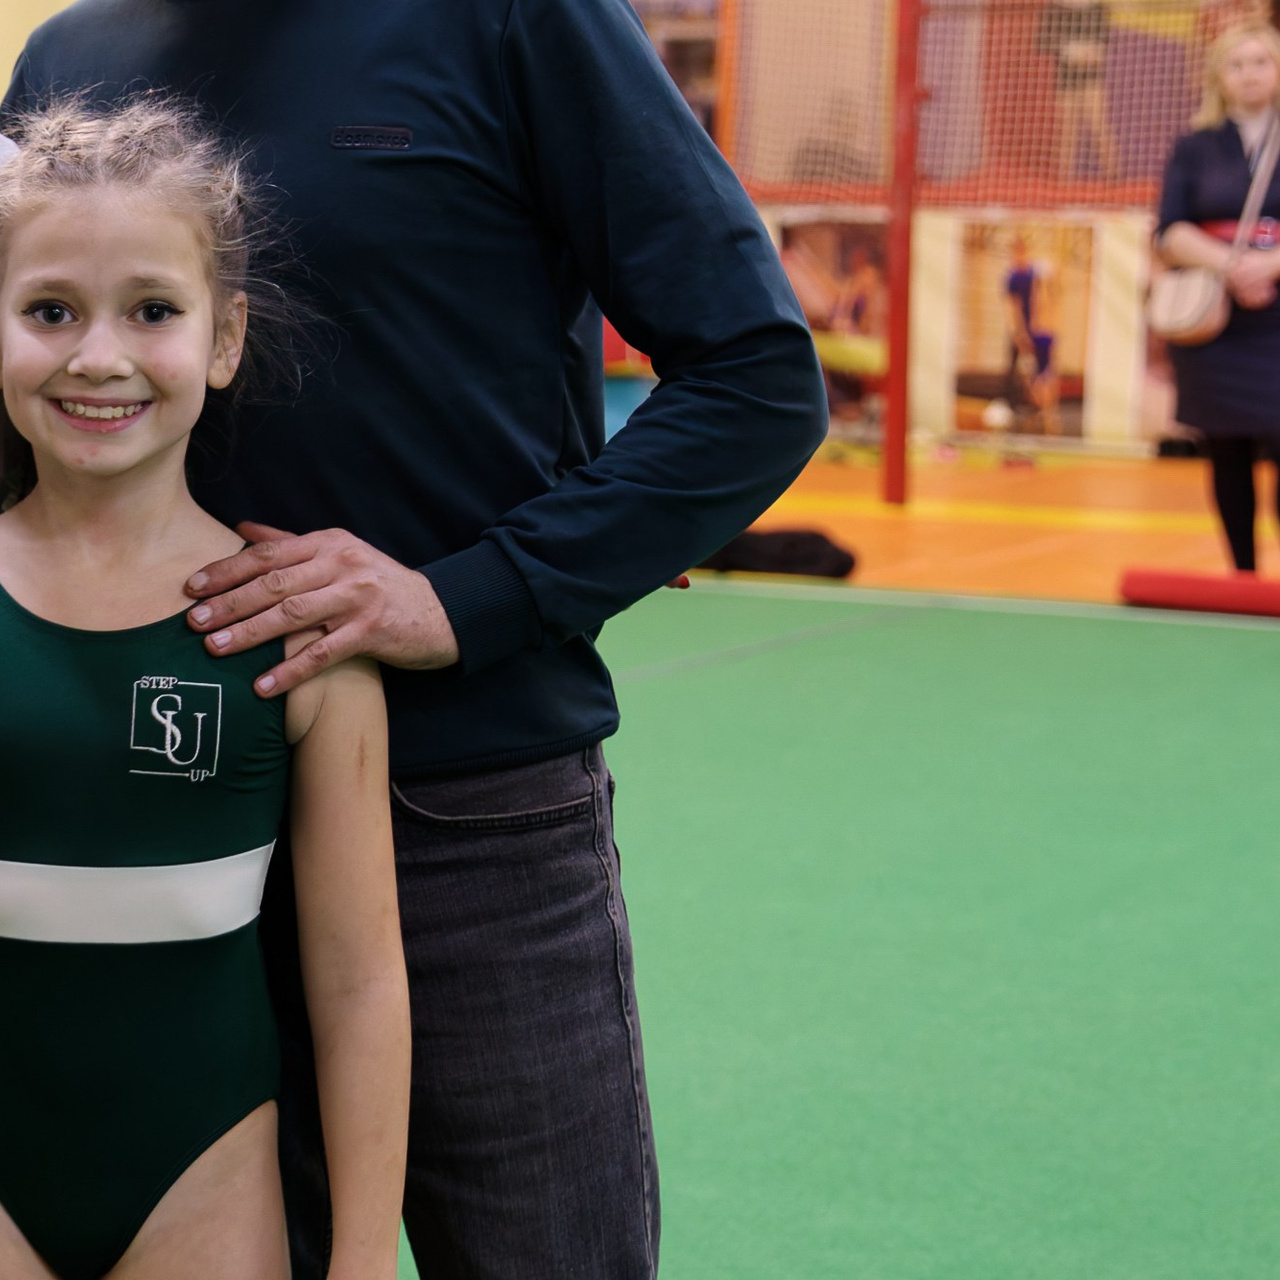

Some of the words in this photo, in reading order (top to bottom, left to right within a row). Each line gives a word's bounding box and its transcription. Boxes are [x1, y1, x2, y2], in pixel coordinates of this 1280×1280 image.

[140, 675, 178, 689] STEP
[151, 693, 207, 765] SU
[190, 769, 209, 782] UP
